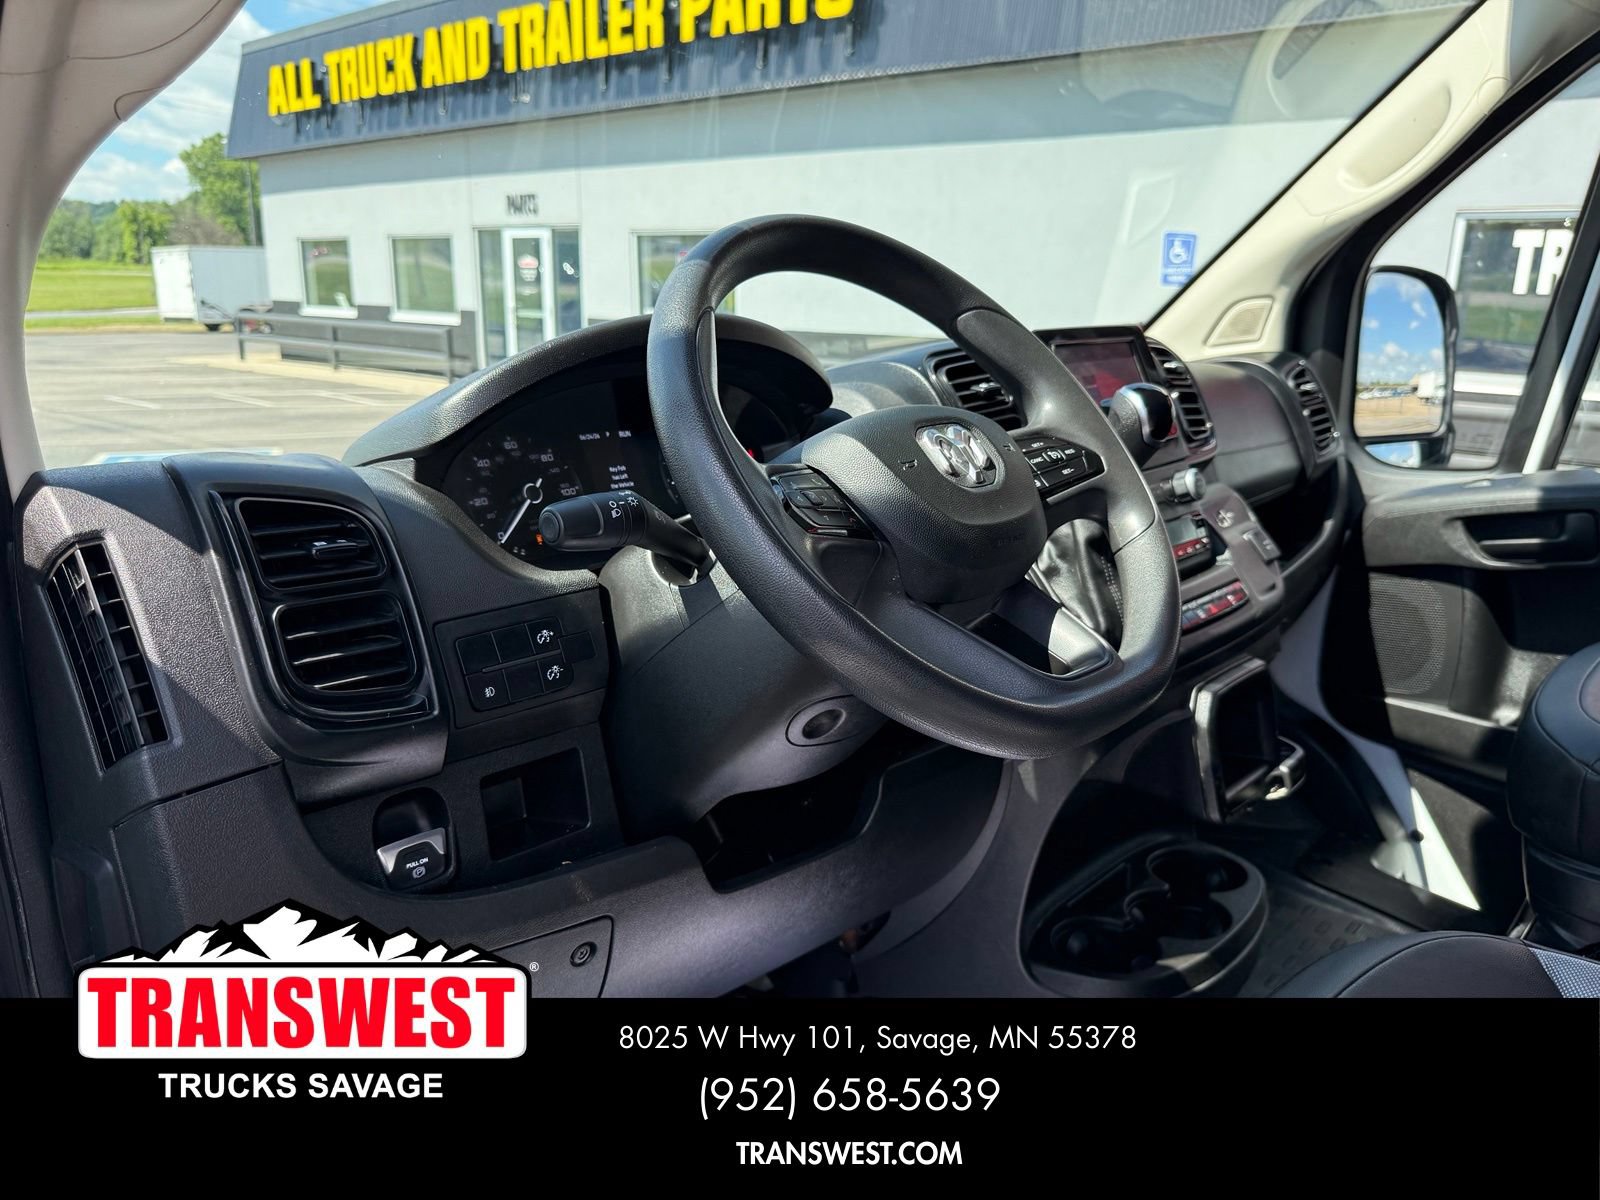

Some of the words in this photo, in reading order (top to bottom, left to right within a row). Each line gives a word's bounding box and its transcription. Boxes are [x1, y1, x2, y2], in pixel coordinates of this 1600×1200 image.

[267, 60, 322, 116] ALL
[323, 33, 418, 105] TRUCK
[421, 16, 491, 89] AND
[497, 0, 665, 74] TRAILER
[678, 0, 855, 43] PAR
[476, 459, 490, 467] 40
[405, 860, 420, 869] PULL
[419, 856, 429, 864] ON
